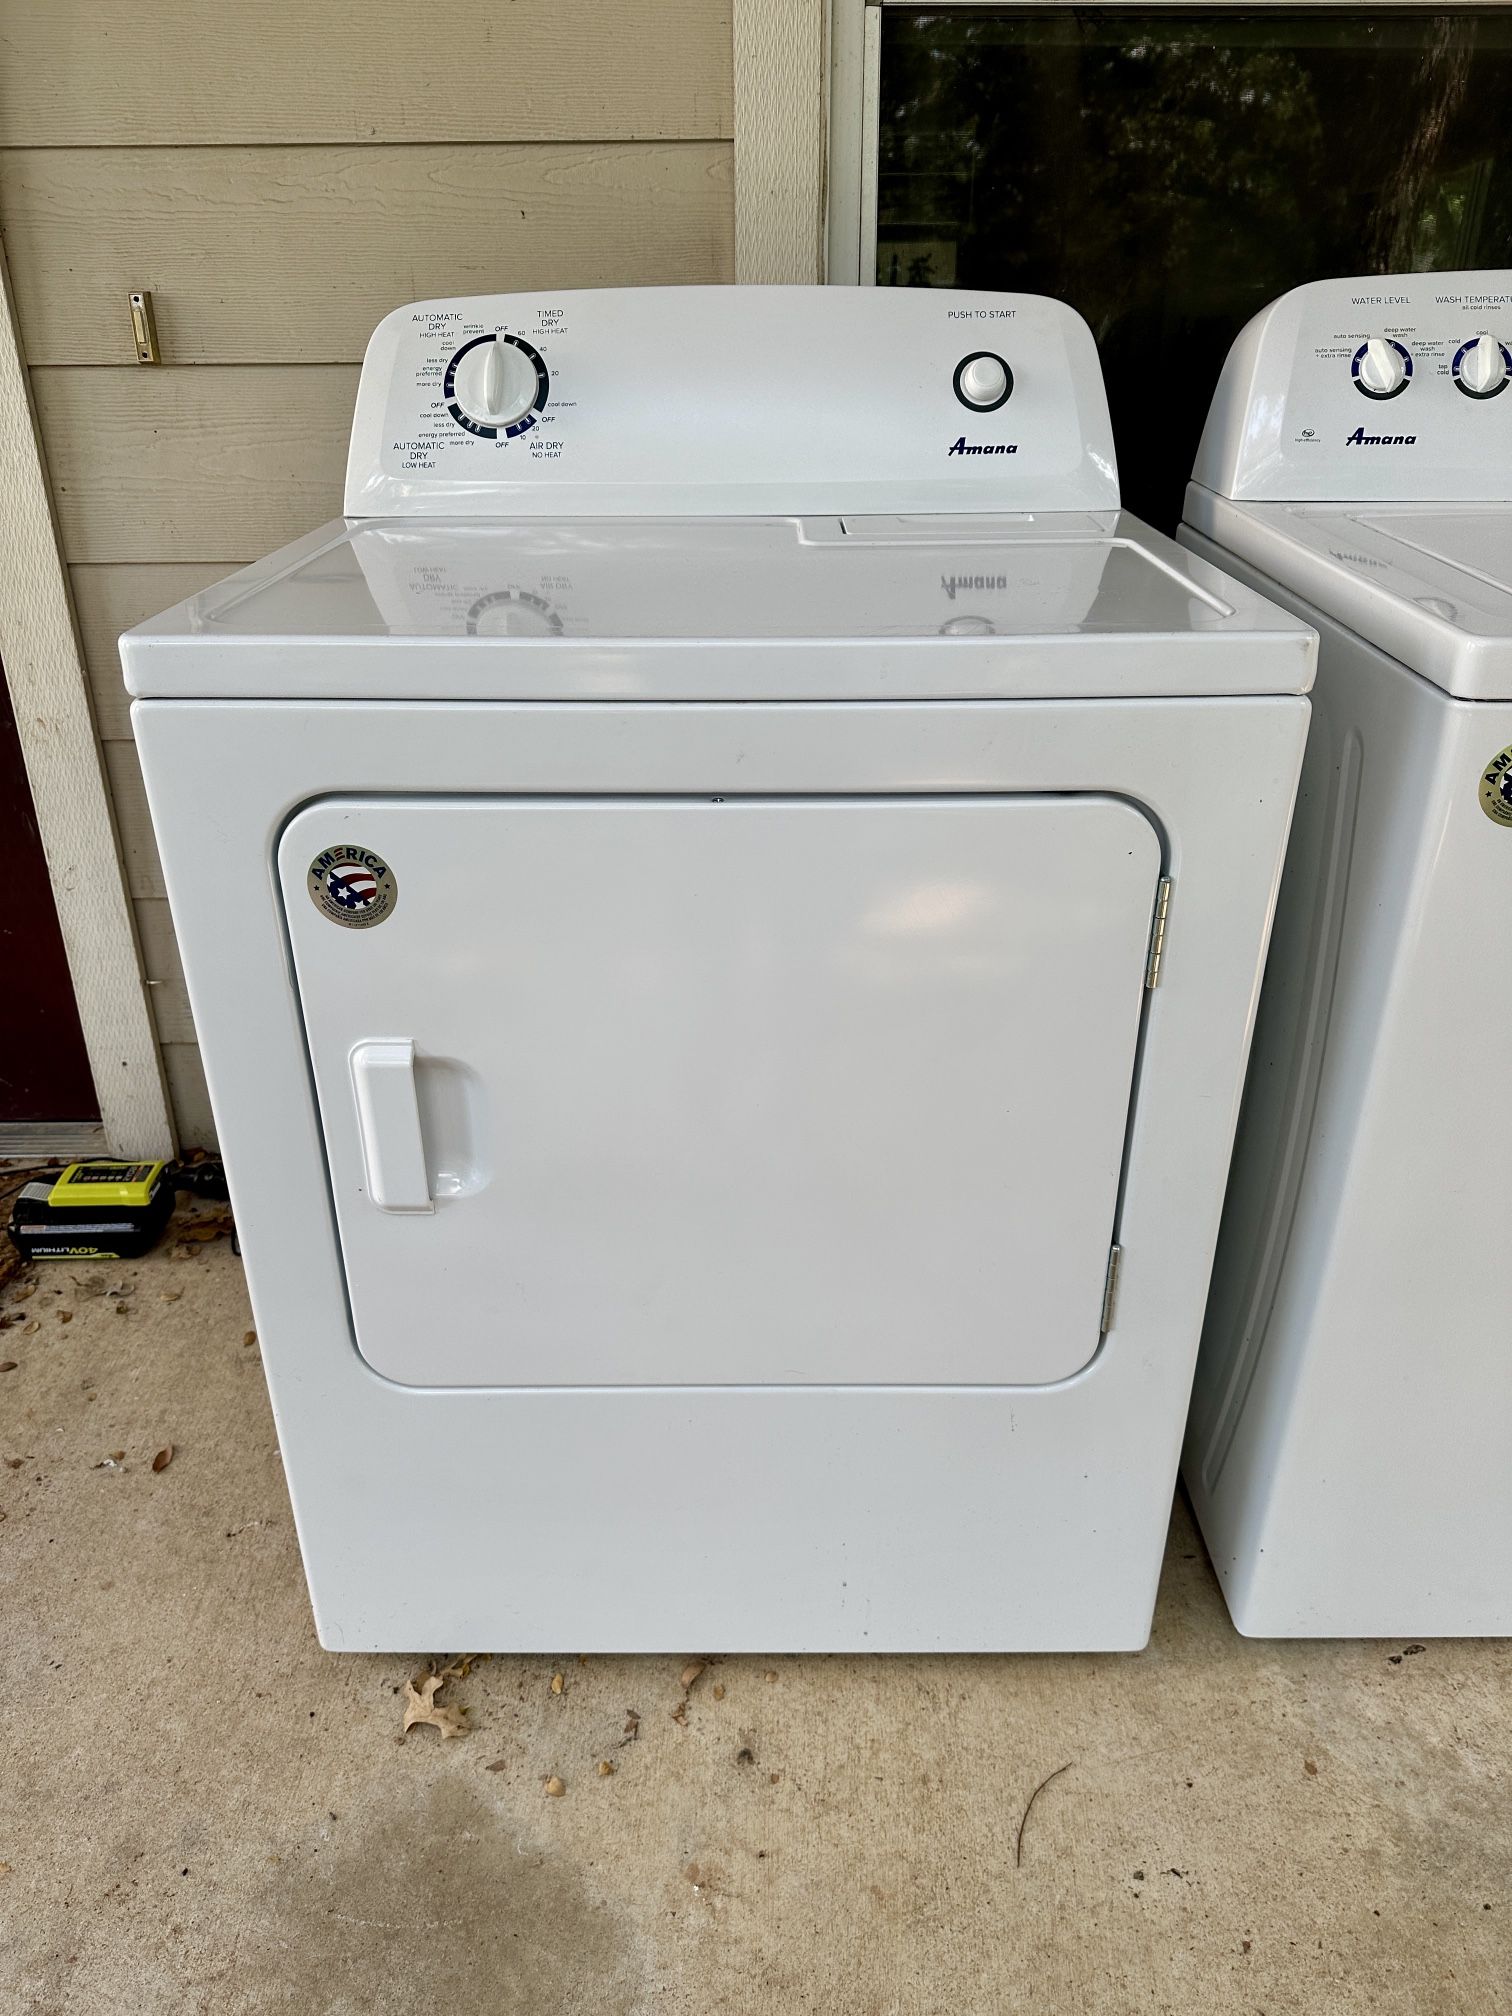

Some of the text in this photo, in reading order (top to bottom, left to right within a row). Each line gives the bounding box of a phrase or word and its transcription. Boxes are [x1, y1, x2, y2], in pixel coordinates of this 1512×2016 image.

[1351, 296, 1411, 305] WATER LEVEL
[412, 313, 463, 321] AUTOMATIC
[537, 310, 564, 318] TIMED
[541, 319, 559, 327] DRY
[1346, 427, 1417, 447] Amana
[393, 442, 444, 450] AUTOMATIC
[948, 437, 1018, 456] Amana
[410, 452, 428, 460] DRY
[311, 847, 387, 880] AMERICA
